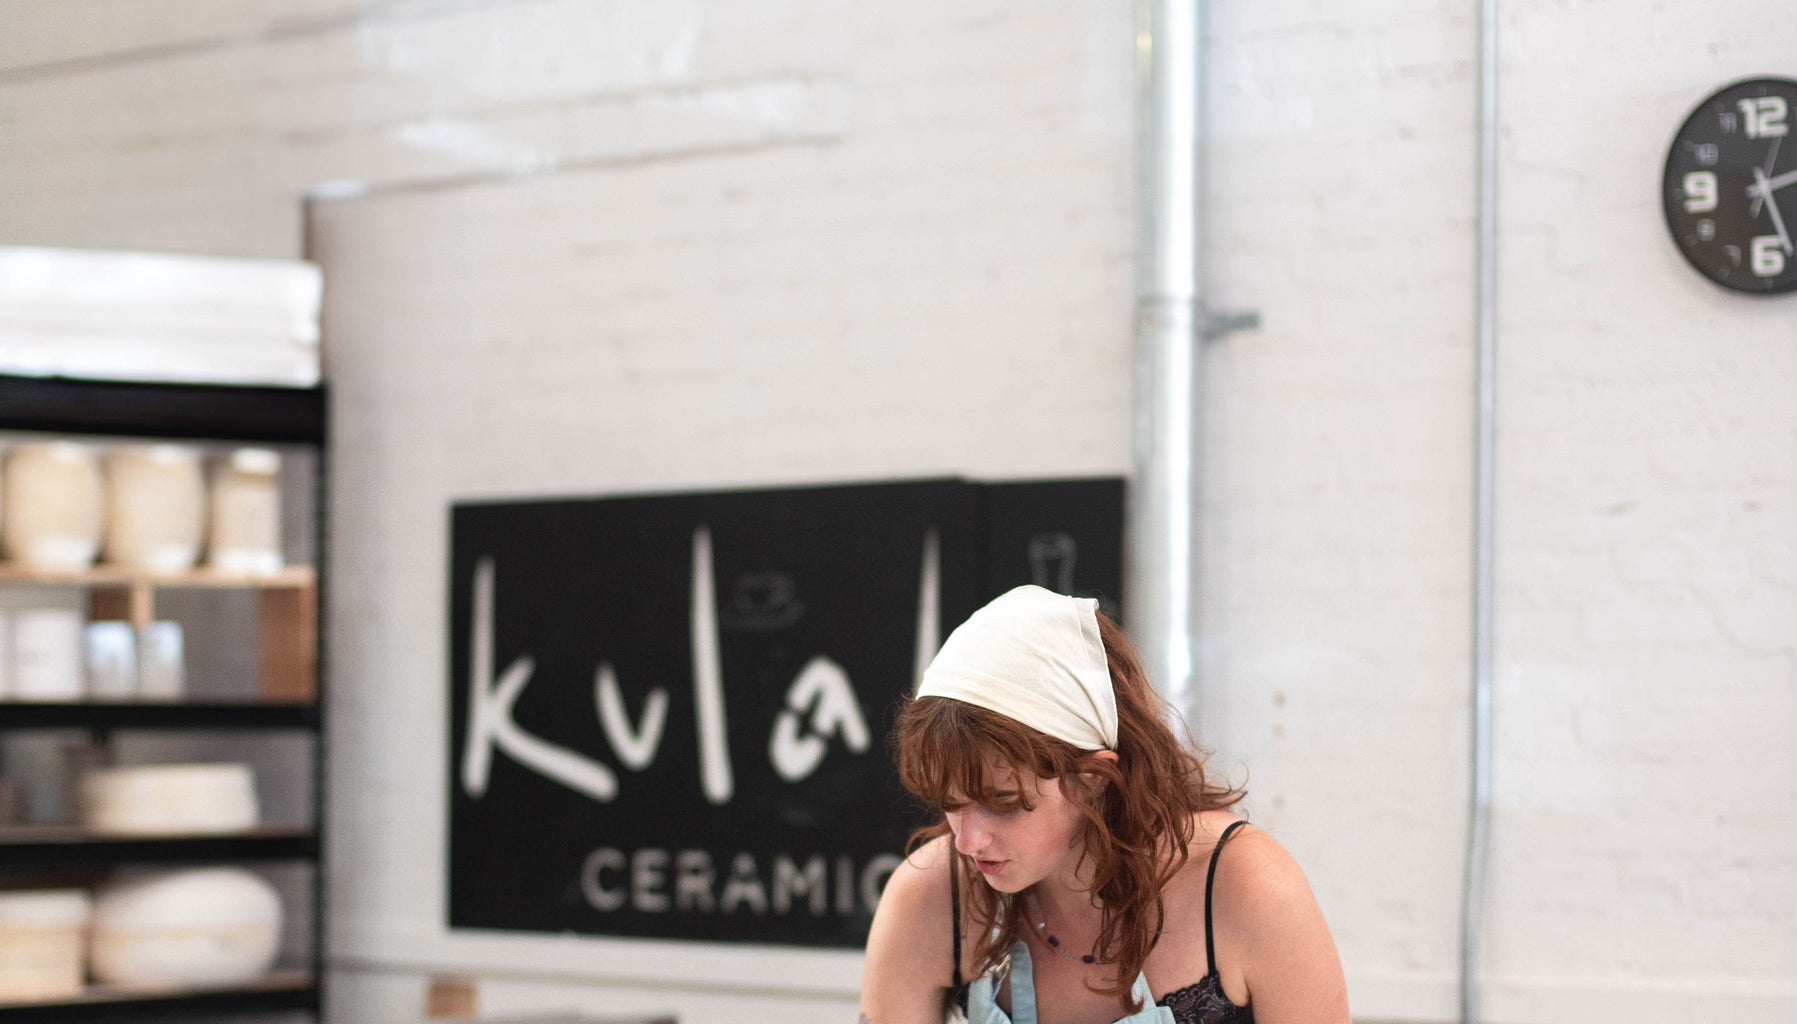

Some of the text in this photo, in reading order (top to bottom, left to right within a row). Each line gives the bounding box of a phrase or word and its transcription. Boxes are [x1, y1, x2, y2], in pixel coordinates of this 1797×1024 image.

[1736, 95, 1790, 139] 12
[1682, 170, 1719, 213] 9
[1750, 233, 1786, 277] 6
